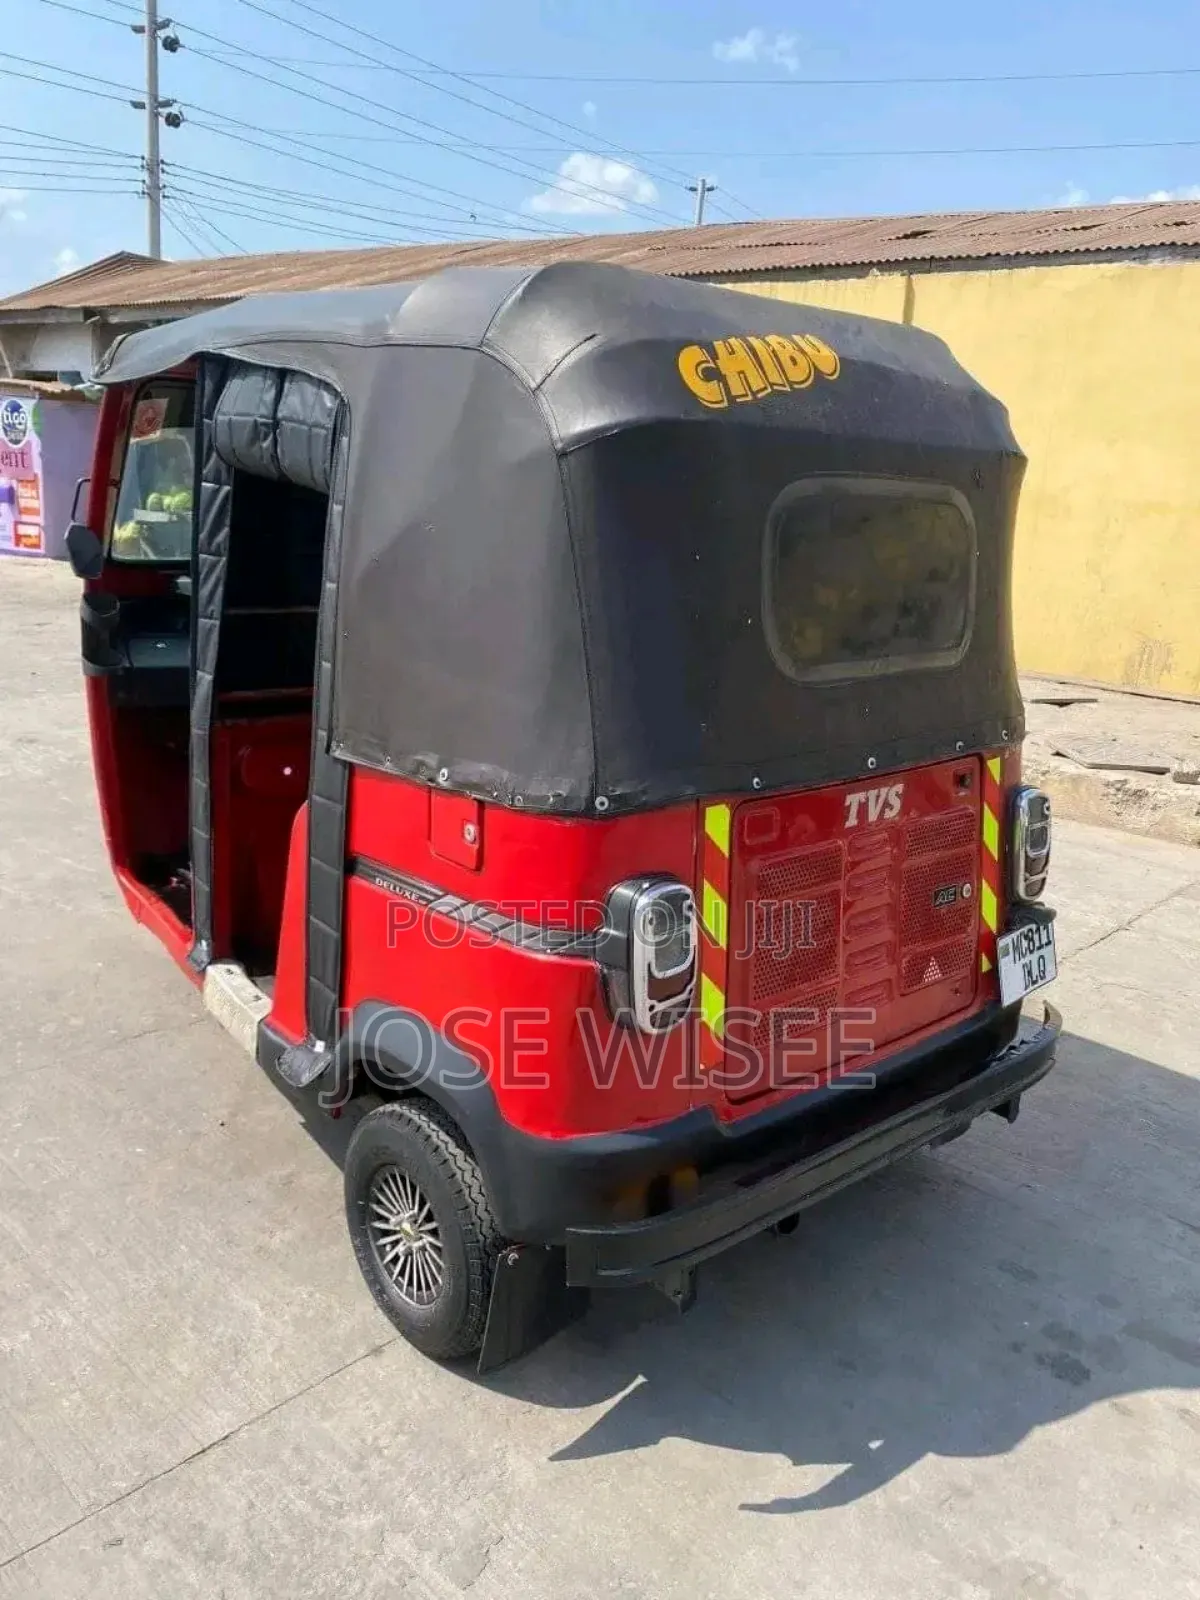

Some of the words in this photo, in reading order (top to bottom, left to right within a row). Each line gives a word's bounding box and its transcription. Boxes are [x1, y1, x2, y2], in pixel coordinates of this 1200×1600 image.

[678, 334, 840, 409] CHIBU
[4, 406, 27, 430] tigo
[0, 450, 27, 468] ent
[844, 783, 905, 829] TVS
[375, 877, 420, 902] DELUXE
[1011, 924, 1052, 965] MC811
